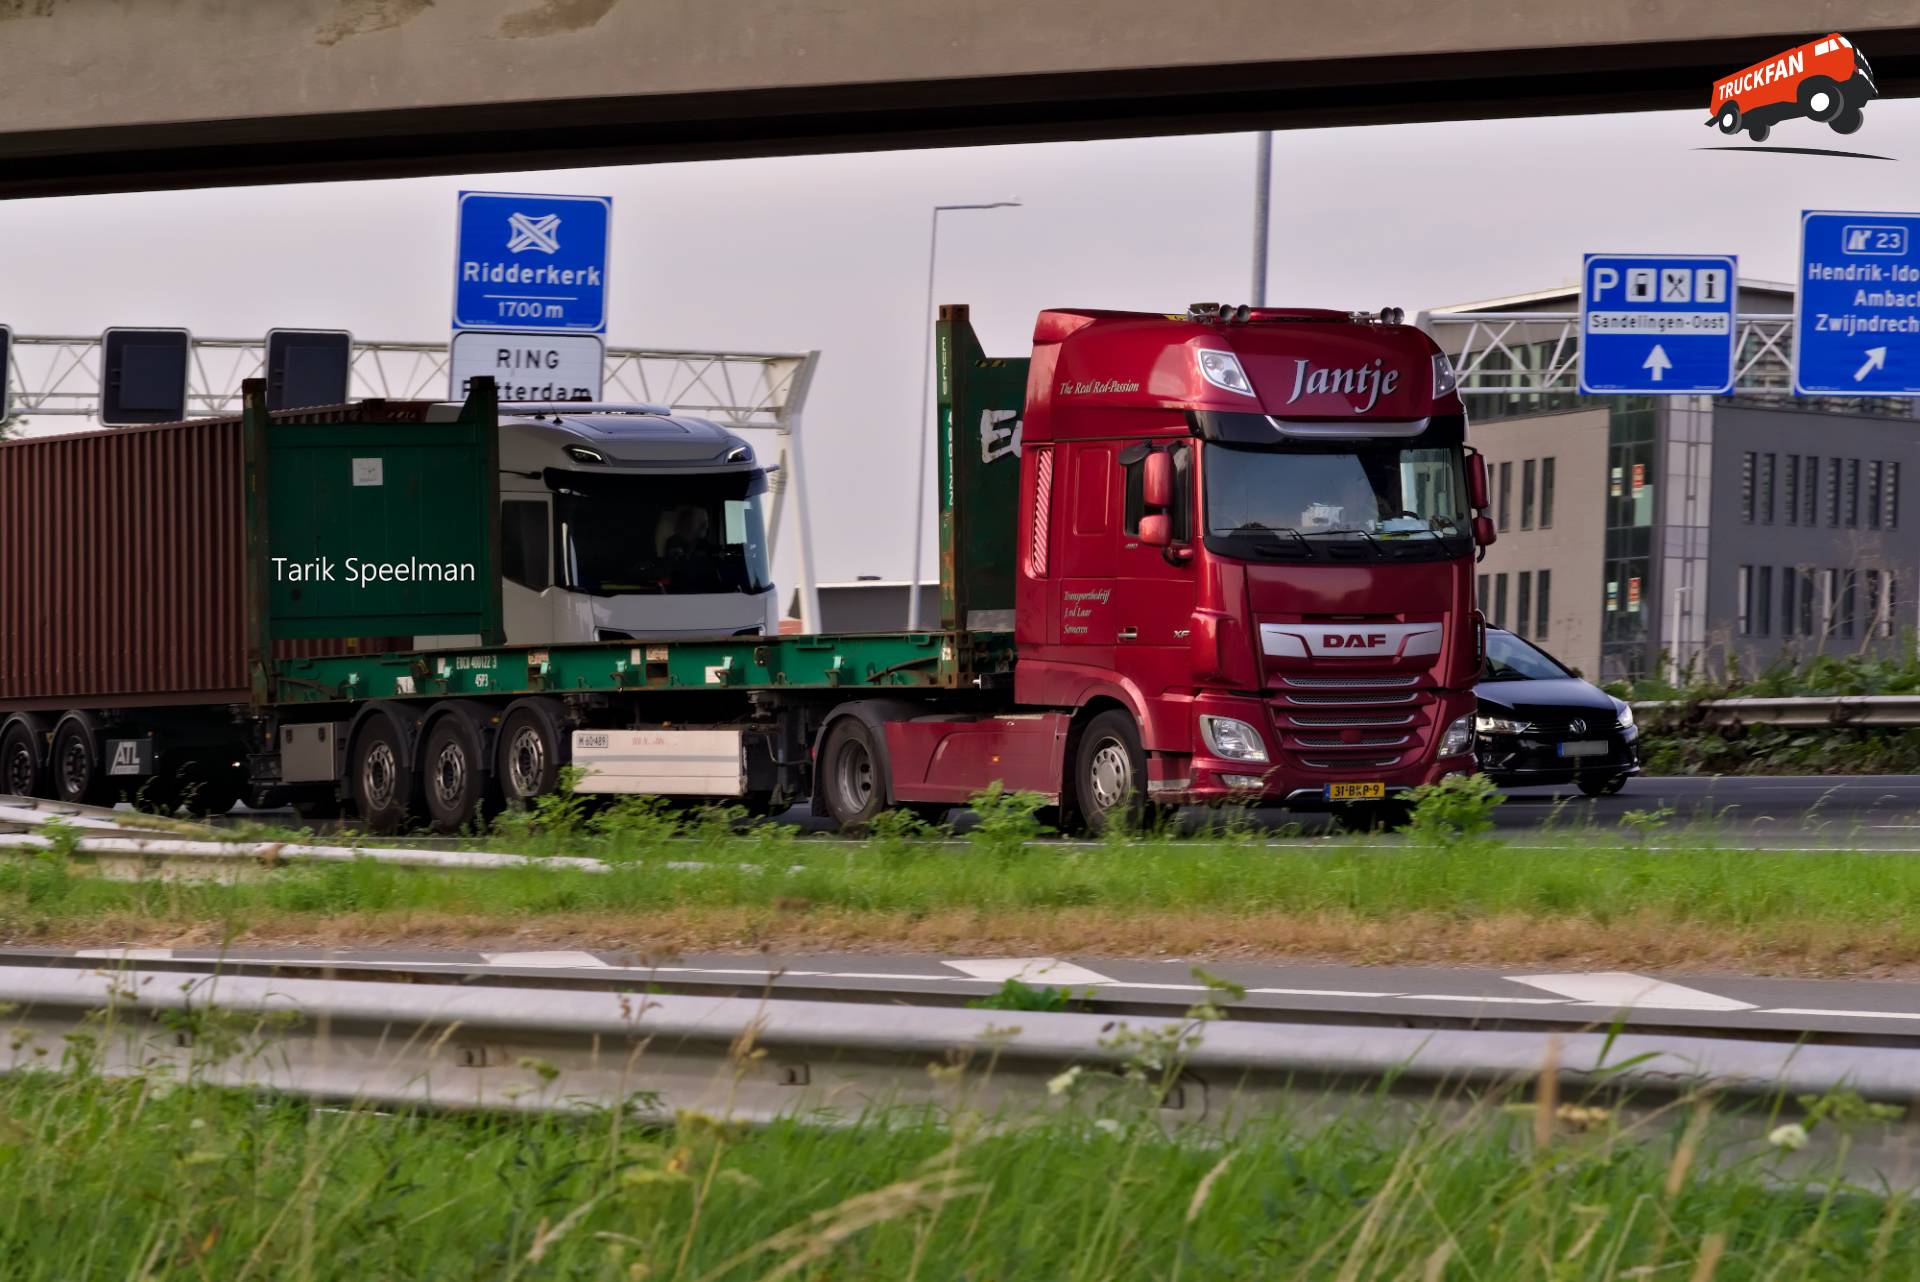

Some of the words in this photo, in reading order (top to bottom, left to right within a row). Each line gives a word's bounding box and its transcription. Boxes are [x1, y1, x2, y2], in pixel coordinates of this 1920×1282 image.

[1875, 233, 1901, 249] 23
[463, 262, 601, 286] Ridderkerk
[1591, 315, 1725, 332] Sandelingen-Oost
[496, 348, 560, 370] RING
[1060, 380, 1074, 395] The
[1074, 379, 1094, 395] Real
[1286, 358, 1398, 414] Jantje
[1323, 634, 1386, 648] DAF
